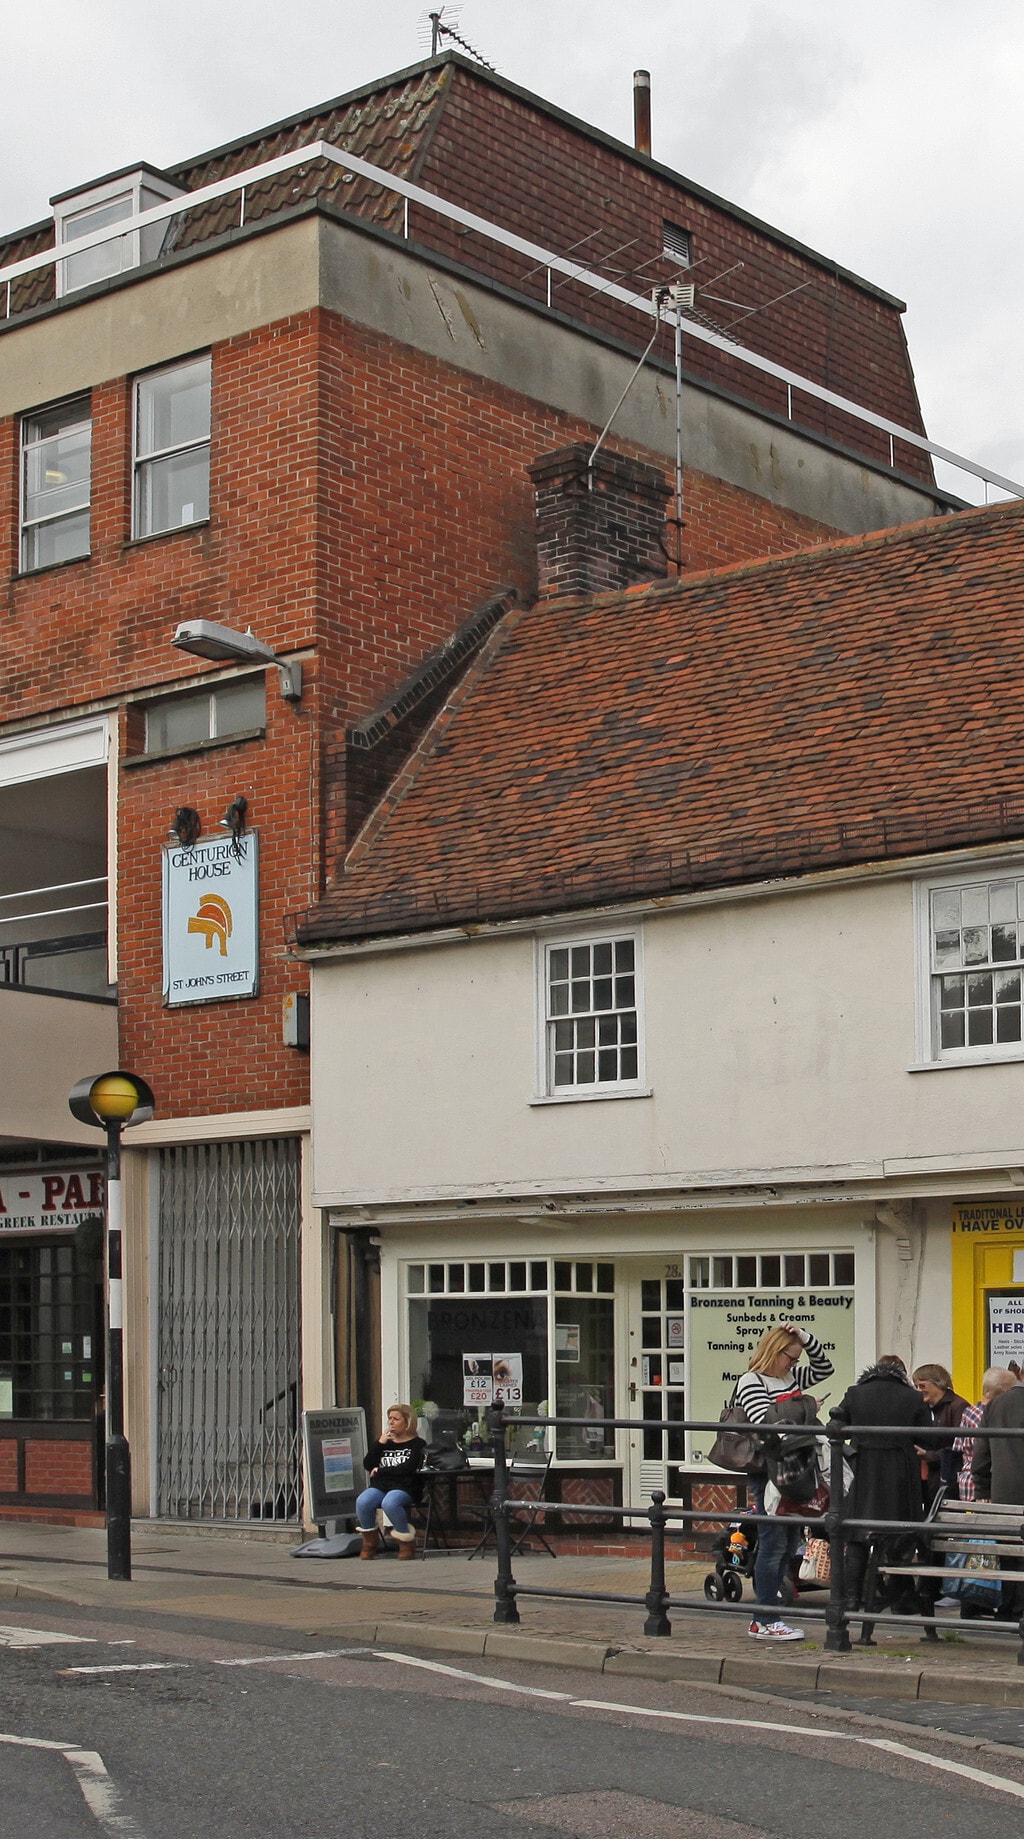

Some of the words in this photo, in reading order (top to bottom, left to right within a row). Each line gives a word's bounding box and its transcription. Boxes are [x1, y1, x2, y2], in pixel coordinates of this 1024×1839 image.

[172, 841, 248, 868] CENTURION
[188, 861, 231, 881] HOUSE
[173, 979, 183, 990] ST
[185, 976, 215, 988] JOHN'S
[216, 970, 250, 985] STREET
[958, 1207, 1013, 1220] TRADITONAL
[962, 1220, 1000, 1232] HAVE
[691, 1296, 745, 1308] Bronzena
[747, 1295, 795, 1309] Tanning
[797, 1296, 805, 1306] &
[809, 1295, 854, 1309] Beauty
[727, 1312, 767, 1322] Sunbeds
[769, 1313, 776, 1322] &
[779, 1312, 815, 1322] Creams
[736, 1325, 765, 1337] Spray
[707, 1341, 745, 1353] Tanning
[747, 1342, 754, 1350] &
[470, 1380, 487, 1388] £12
[470, 1392, 487, 1400] £20
[495, 1387, 521, 1400] £13
